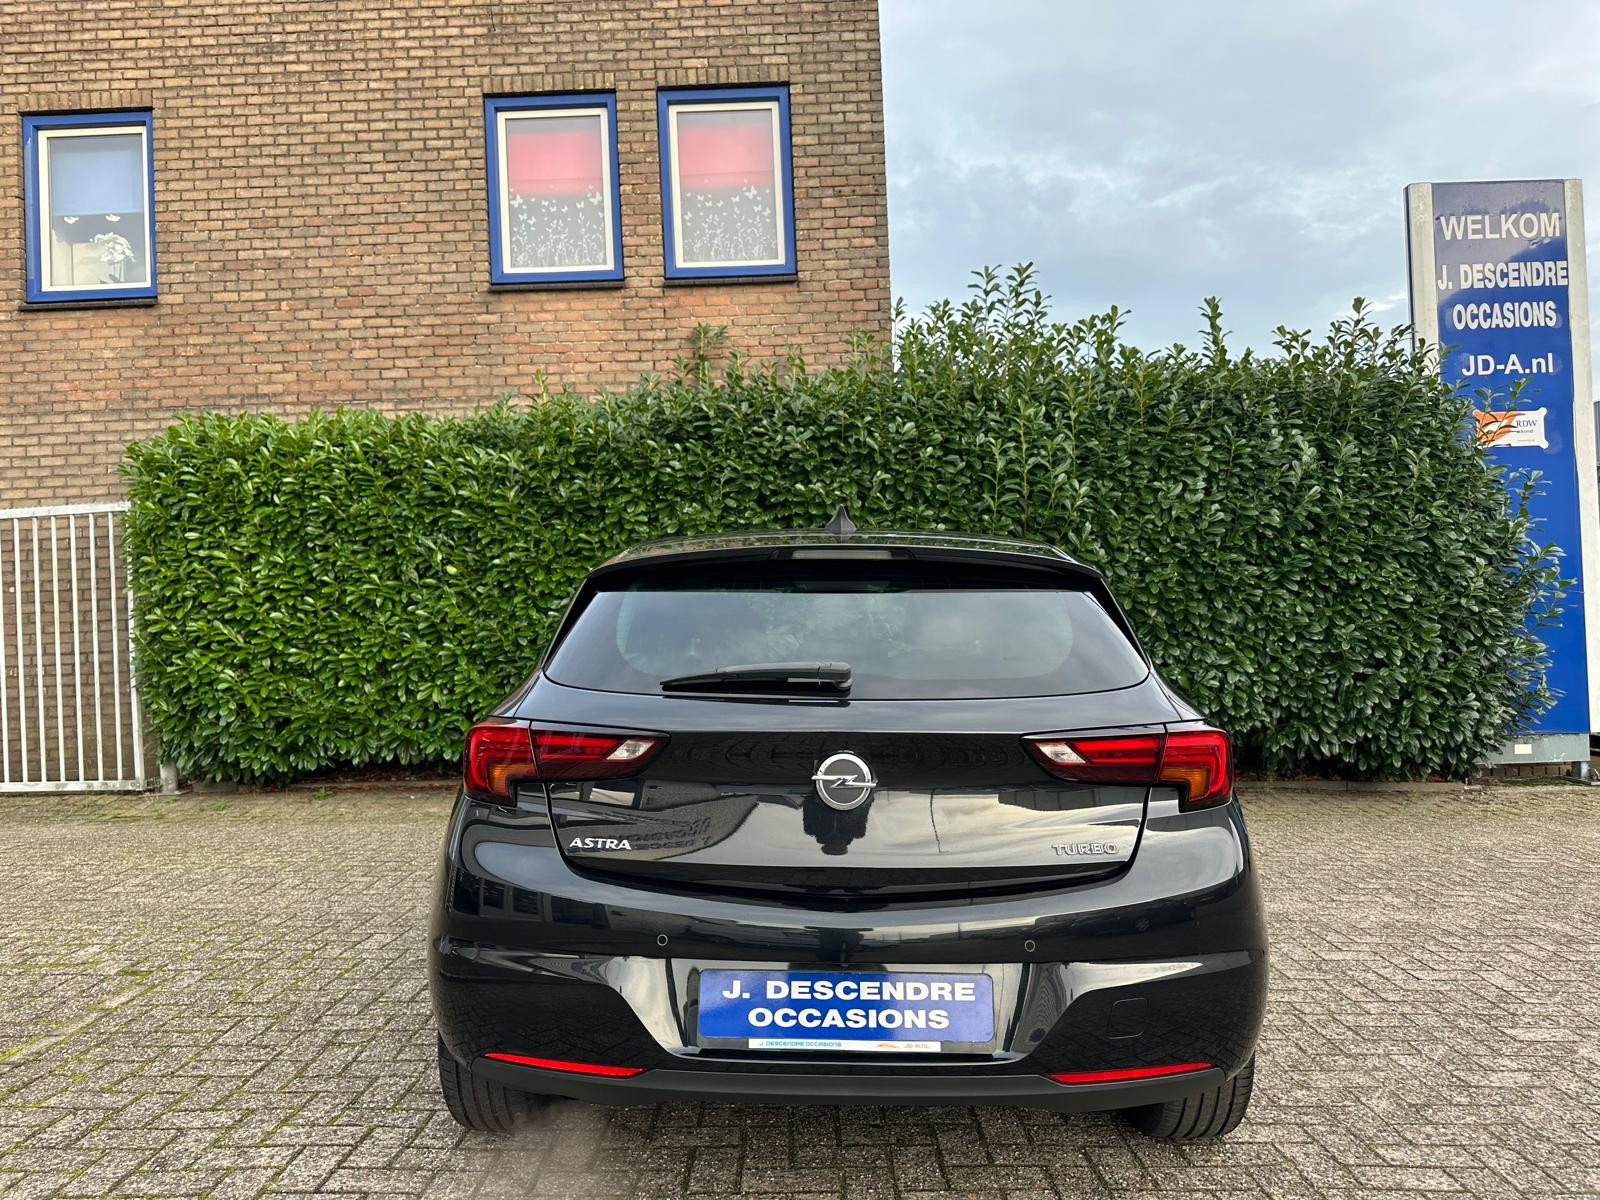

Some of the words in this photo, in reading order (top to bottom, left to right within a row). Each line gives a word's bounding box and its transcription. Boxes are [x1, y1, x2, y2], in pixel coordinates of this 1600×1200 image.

[1439, 213, 1561, 240] WELKOM
[1437, 265, 1453, 290] J.
[1460, 260, 1568, 289] DESCENDRE
[1452, 301, 1557, 329] OCCASIONS
[1461, 353, 1554, 376] JD-A.nl
[1516, 419, 1537, 427] RDW
[569, 837, 632, 850] ASTRA
[1051, 843, 1119, 855] TURBO
[722, 980, 751, 999] J.
[766, 980, 976, 1001] DESCENDRE
[747, 1008, 950, 1029] OCCASIONS
